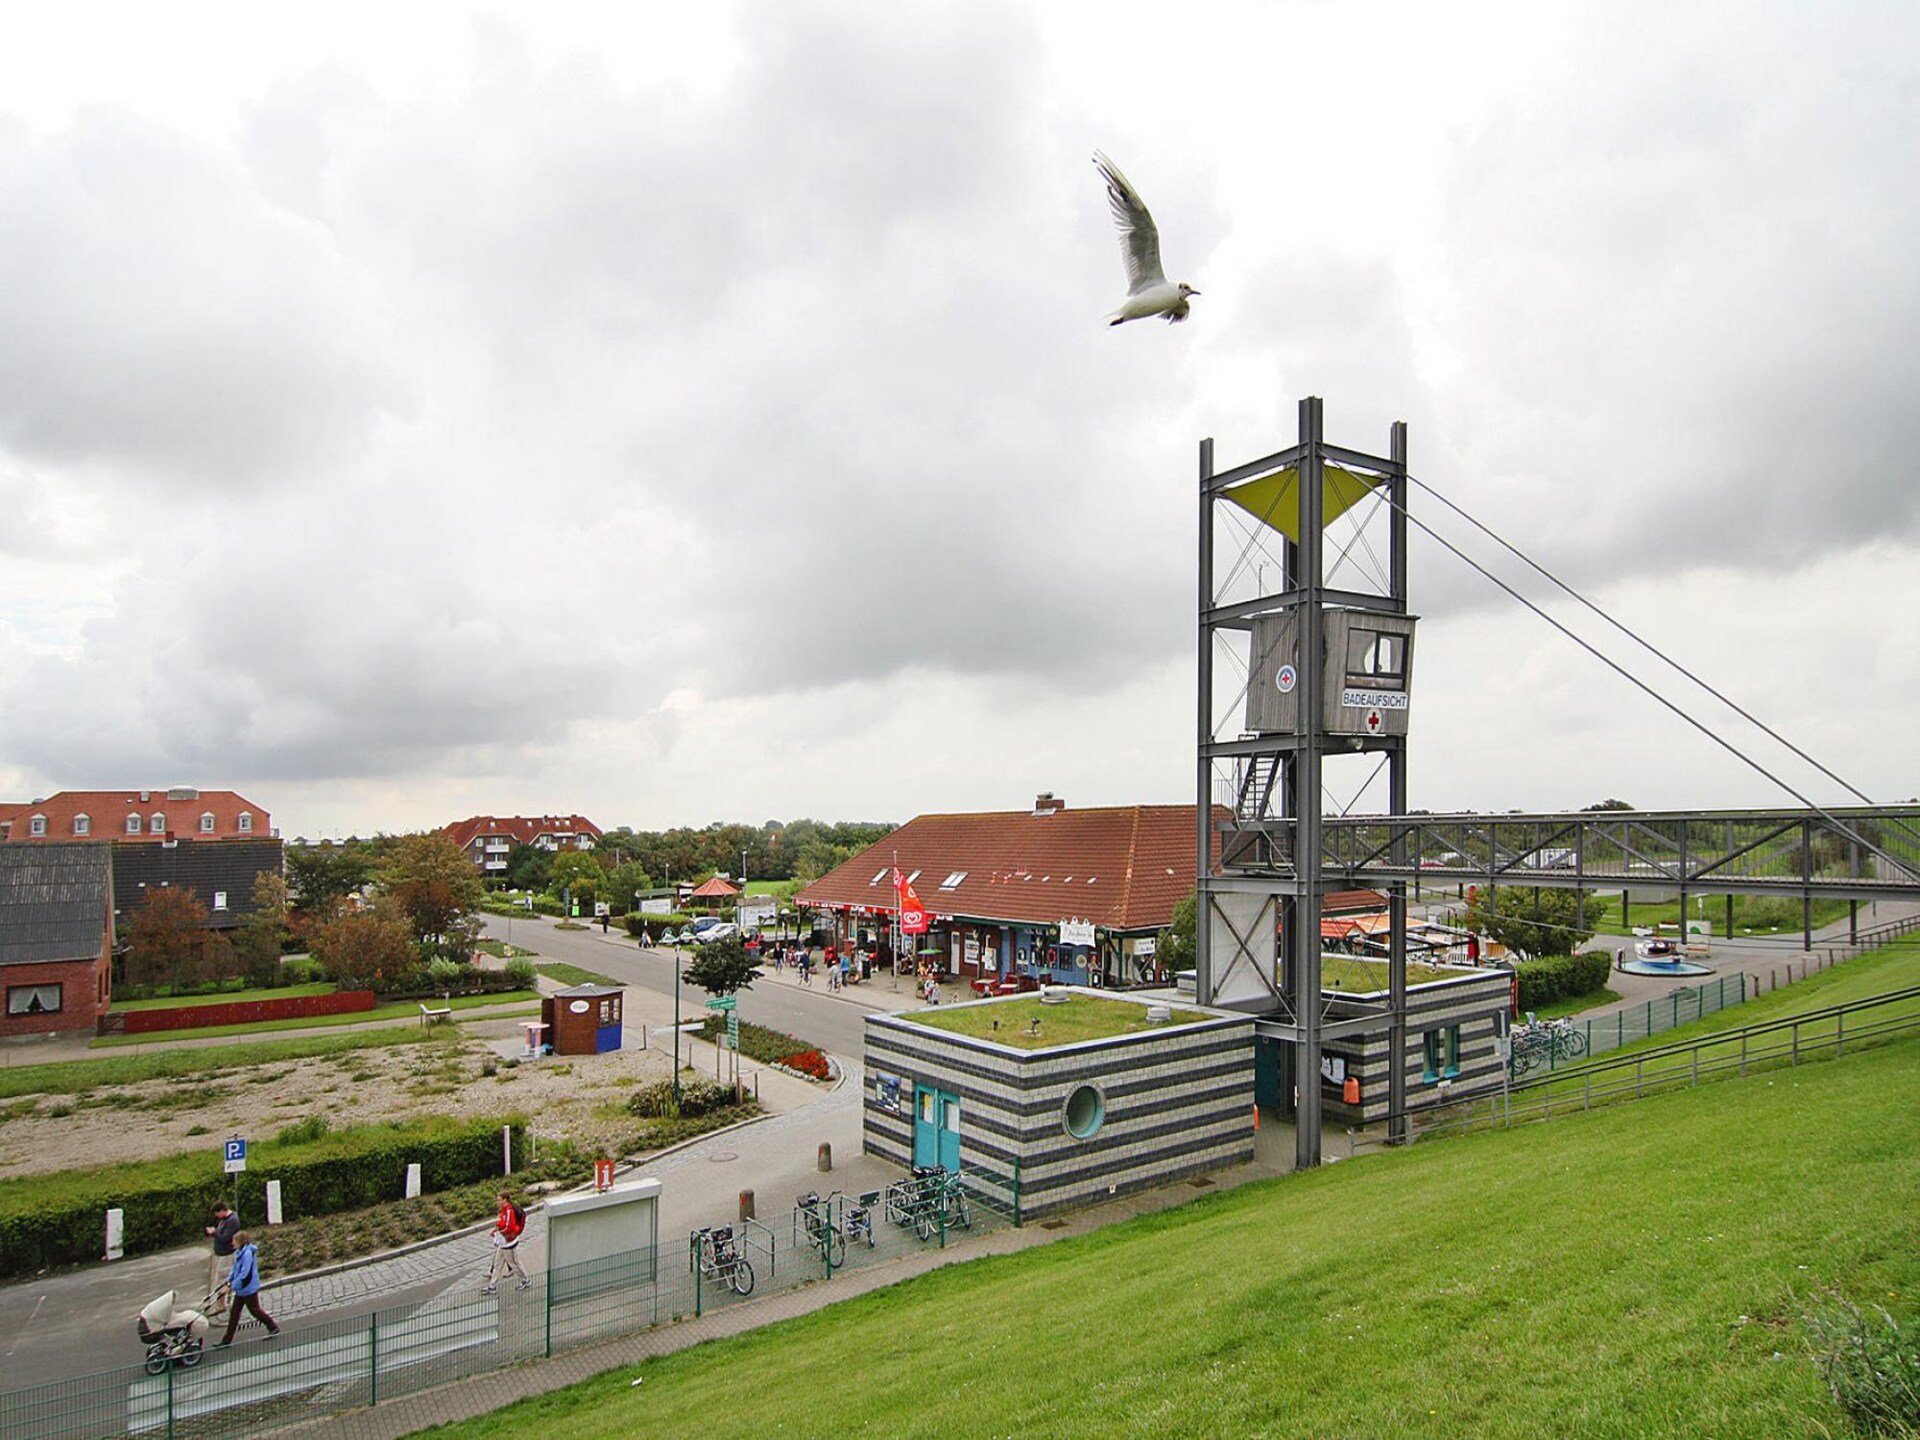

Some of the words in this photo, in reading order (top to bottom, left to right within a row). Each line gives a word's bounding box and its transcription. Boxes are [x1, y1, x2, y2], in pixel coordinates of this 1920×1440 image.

[1343, 693, 1407, 707] BADEAUFSICHT
[228, 1143, 240, 1159] P
[602, 1165, 611, 1186] i
